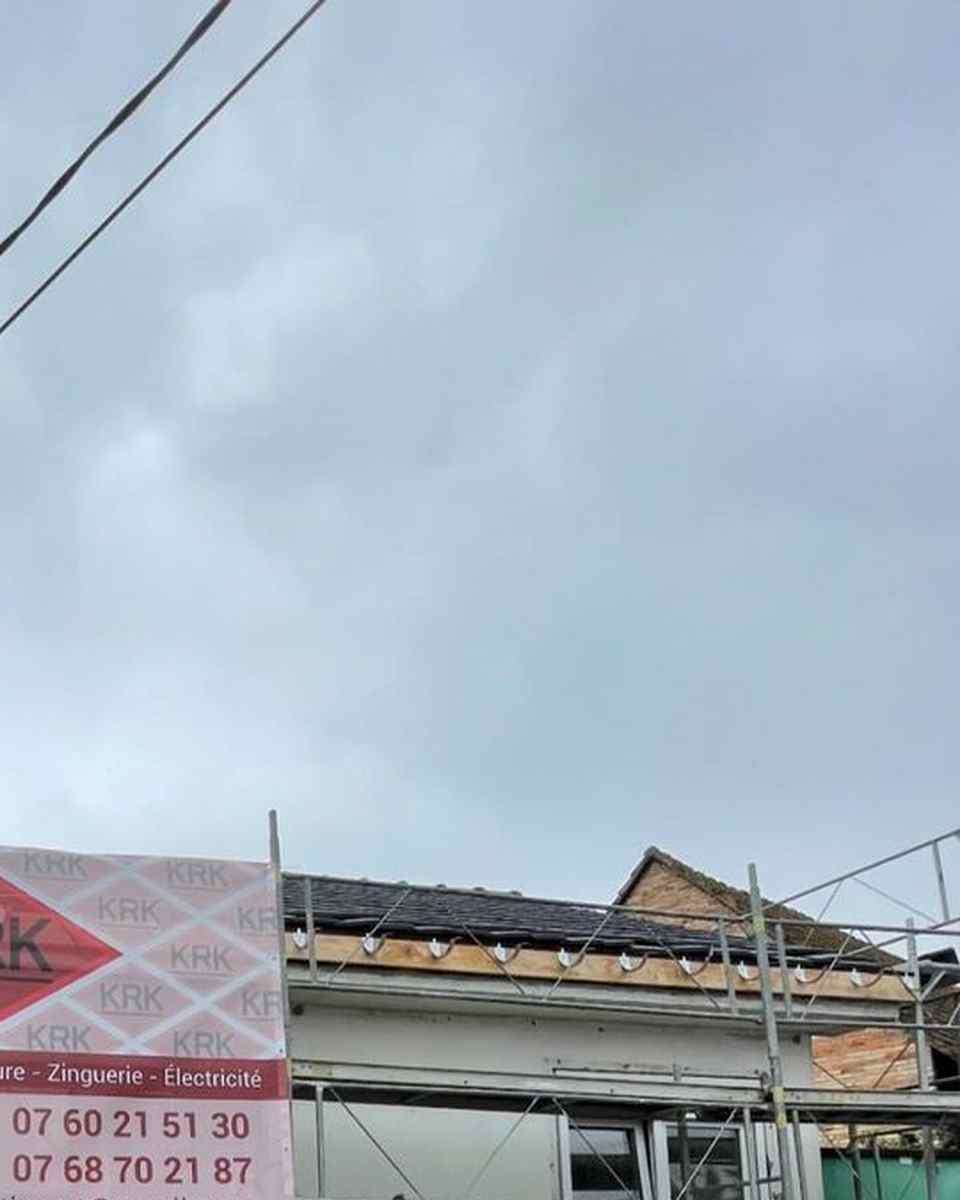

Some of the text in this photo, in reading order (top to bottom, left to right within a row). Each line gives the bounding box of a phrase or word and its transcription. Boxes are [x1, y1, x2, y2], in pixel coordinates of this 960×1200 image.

[23, 850, 87, 877] KRK
[167, 862, 227, 887] KRK
[97, 896, 161, 925] KRK
[170, 943, 234, 972] KRK
[100, 981, 164, 1011] KRK
[27, 1023, 92, 1051] KRK
[173, 1030, 235, 1057] KRK
[47, 1063, 144, 1089] Zinguerie
[164, 1063, 262, 1089] Électricité
[12, 1107, 250, 1139] 07 60 21 51 30
[12, 1154, 253, 1185] 07 68 70 21 87
